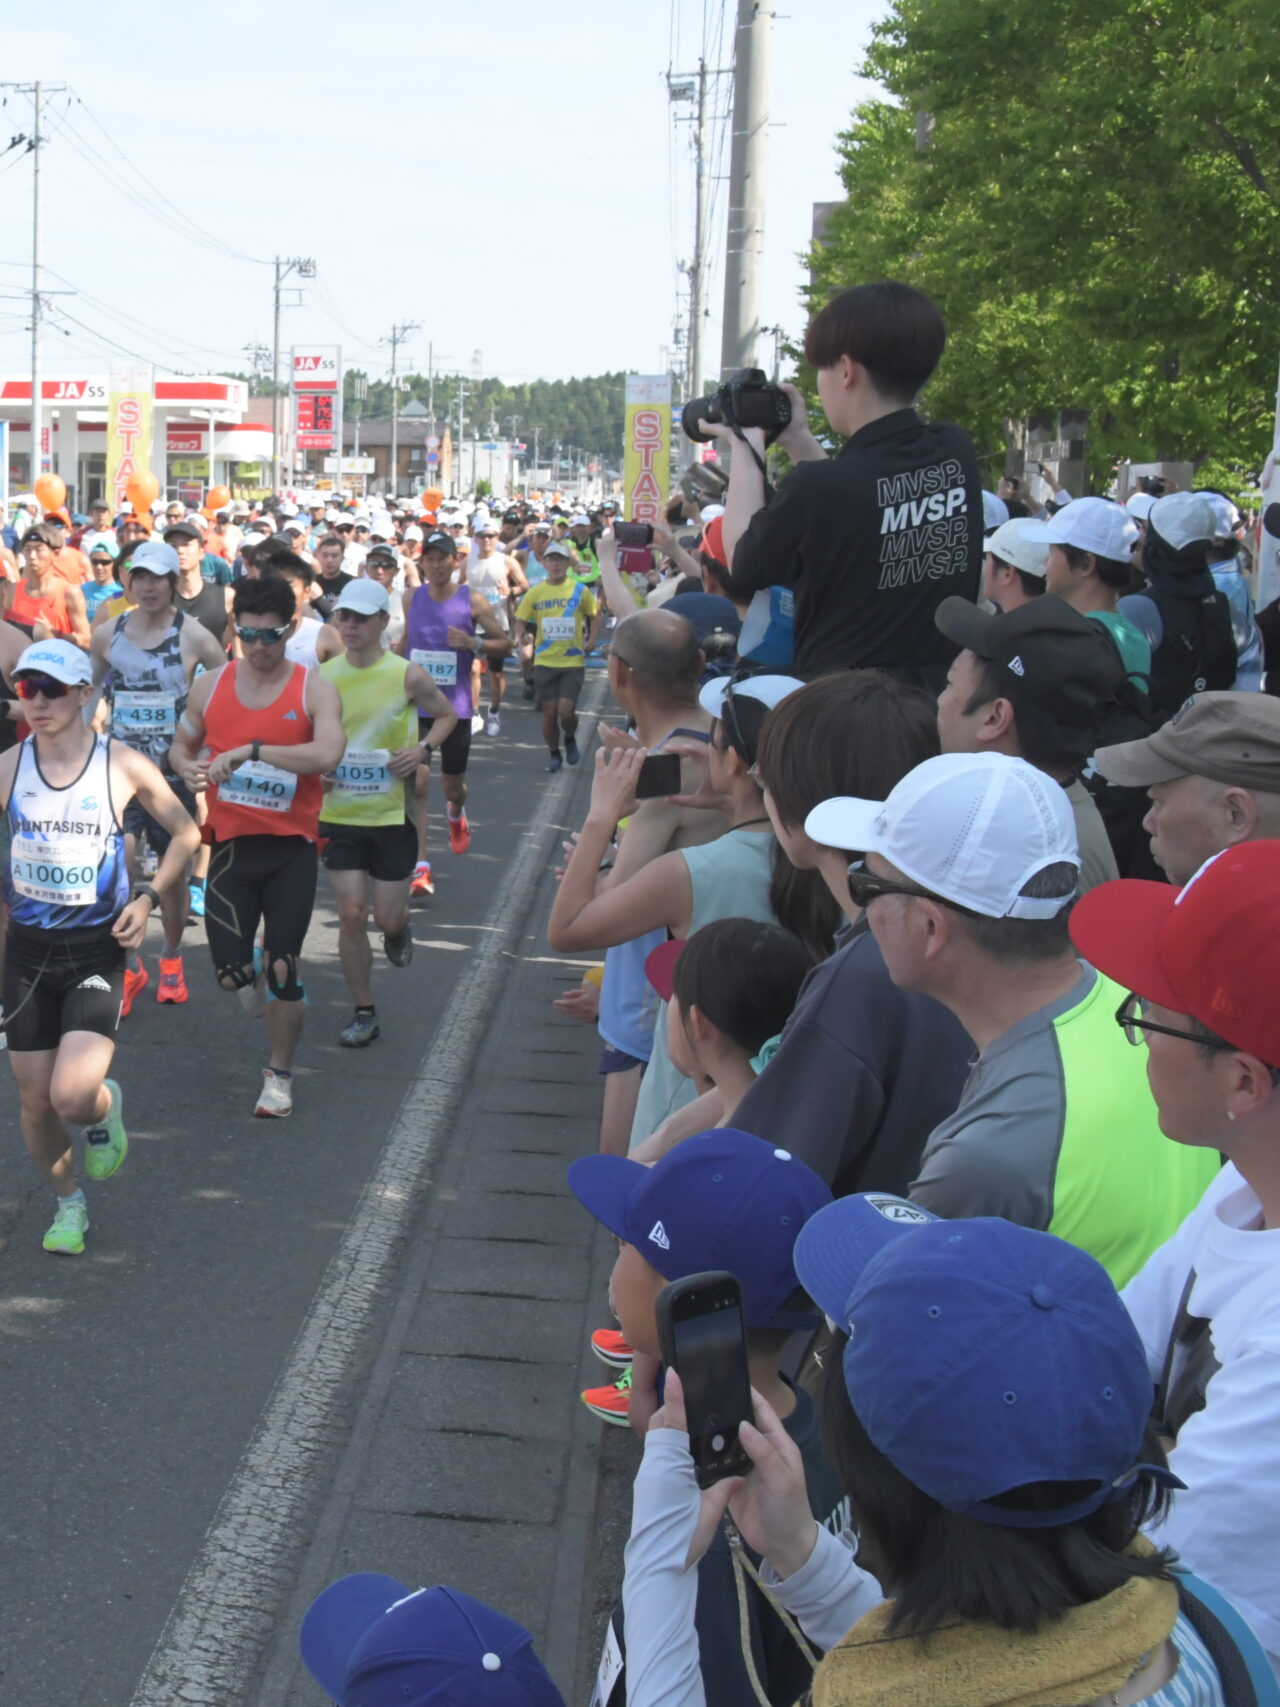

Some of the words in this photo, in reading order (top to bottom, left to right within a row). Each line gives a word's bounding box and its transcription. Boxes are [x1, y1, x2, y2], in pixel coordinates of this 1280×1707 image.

[296, 357, 316, 369] JA
[55, 382, 81, 398] JA
[877, 459, 966, 507] MVSP.
[880, 487, 968, 535] MVSP.
[880, 515, 969, 563] MVSP.
[878, 545, 969, 590] MVSP.
[28, 652, 65, 666] HOKA
[130, 708, 167, 721] 438
[243, 777, 285, 797] 140
